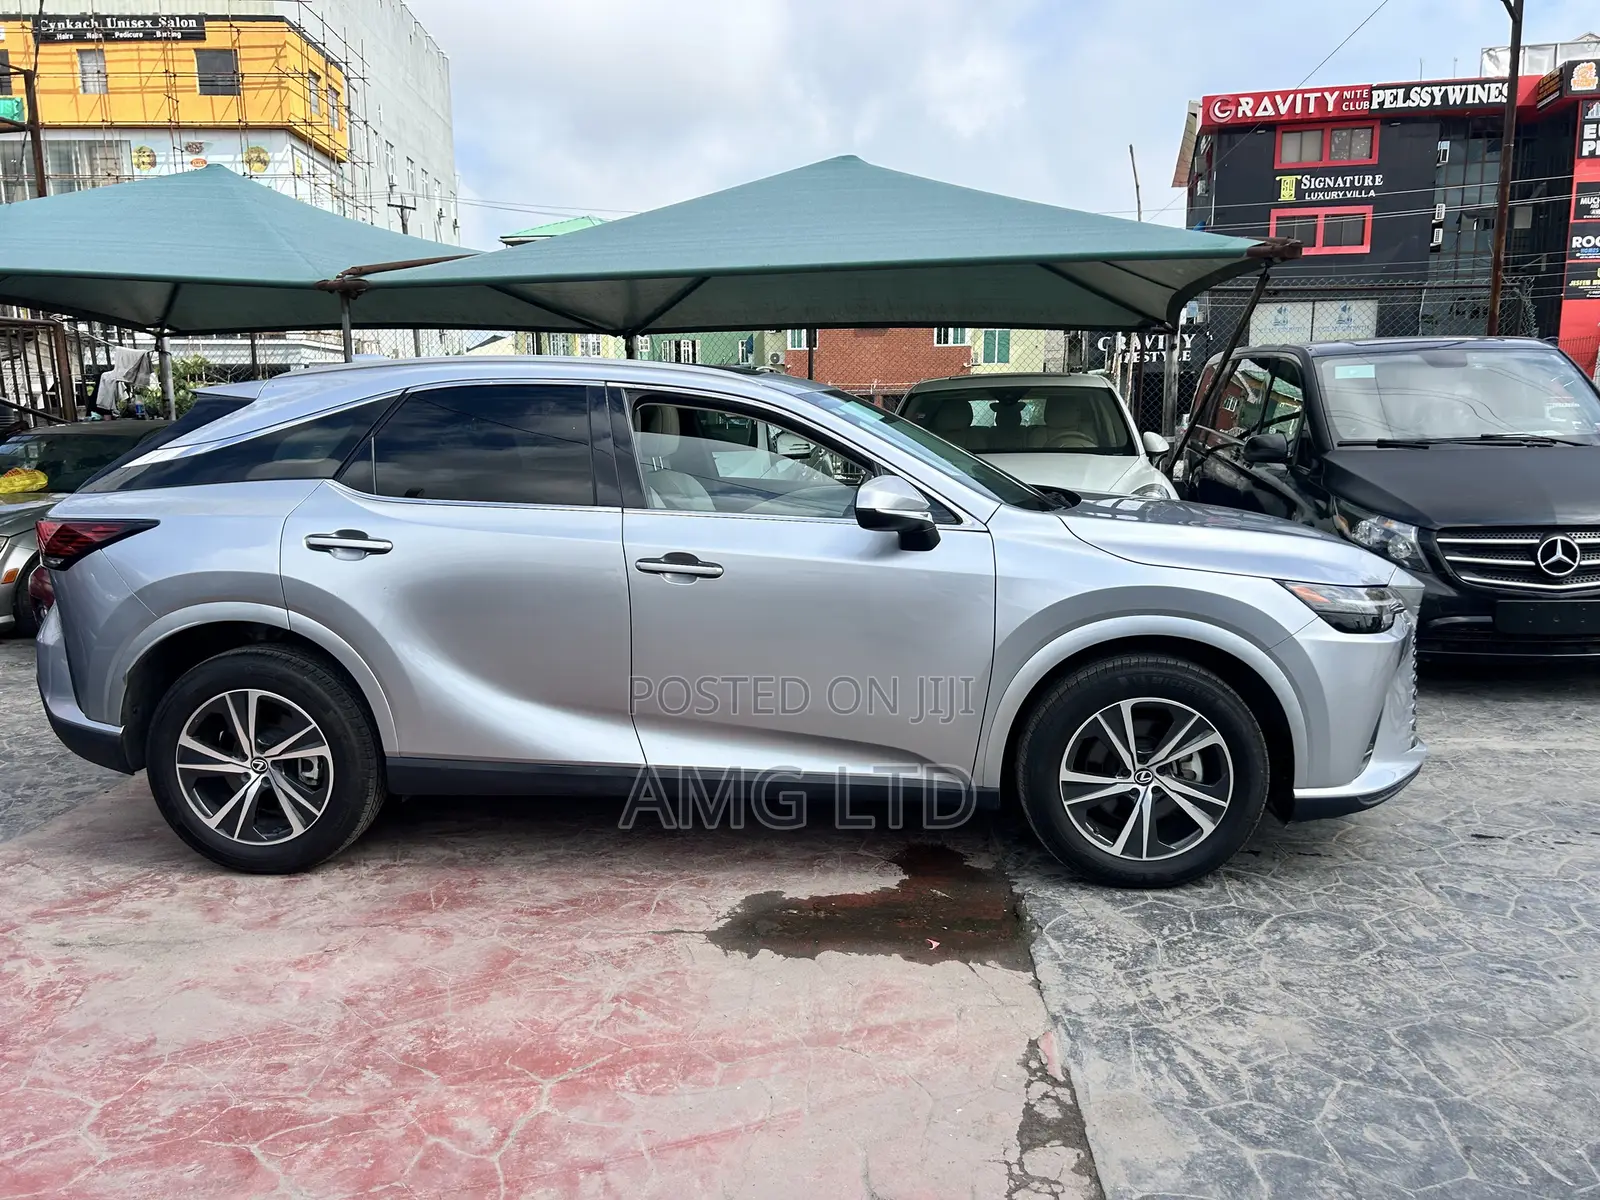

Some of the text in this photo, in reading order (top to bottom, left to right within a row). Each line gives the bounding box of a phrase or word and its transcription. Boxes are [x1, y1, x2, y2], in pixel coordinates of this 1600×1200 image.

[40, 16, 197, 32] Cynkach Unisex Salon
[1342, 89, 1369, 100] NITE
[1209, 91, 1340, 123] GRAVITY
[1342, 100, 1370, 111] CLUB
[1305, 189, 1376, 200] LUXURY VILLA
[1097, 333, 1197, 352] GRAVIY
